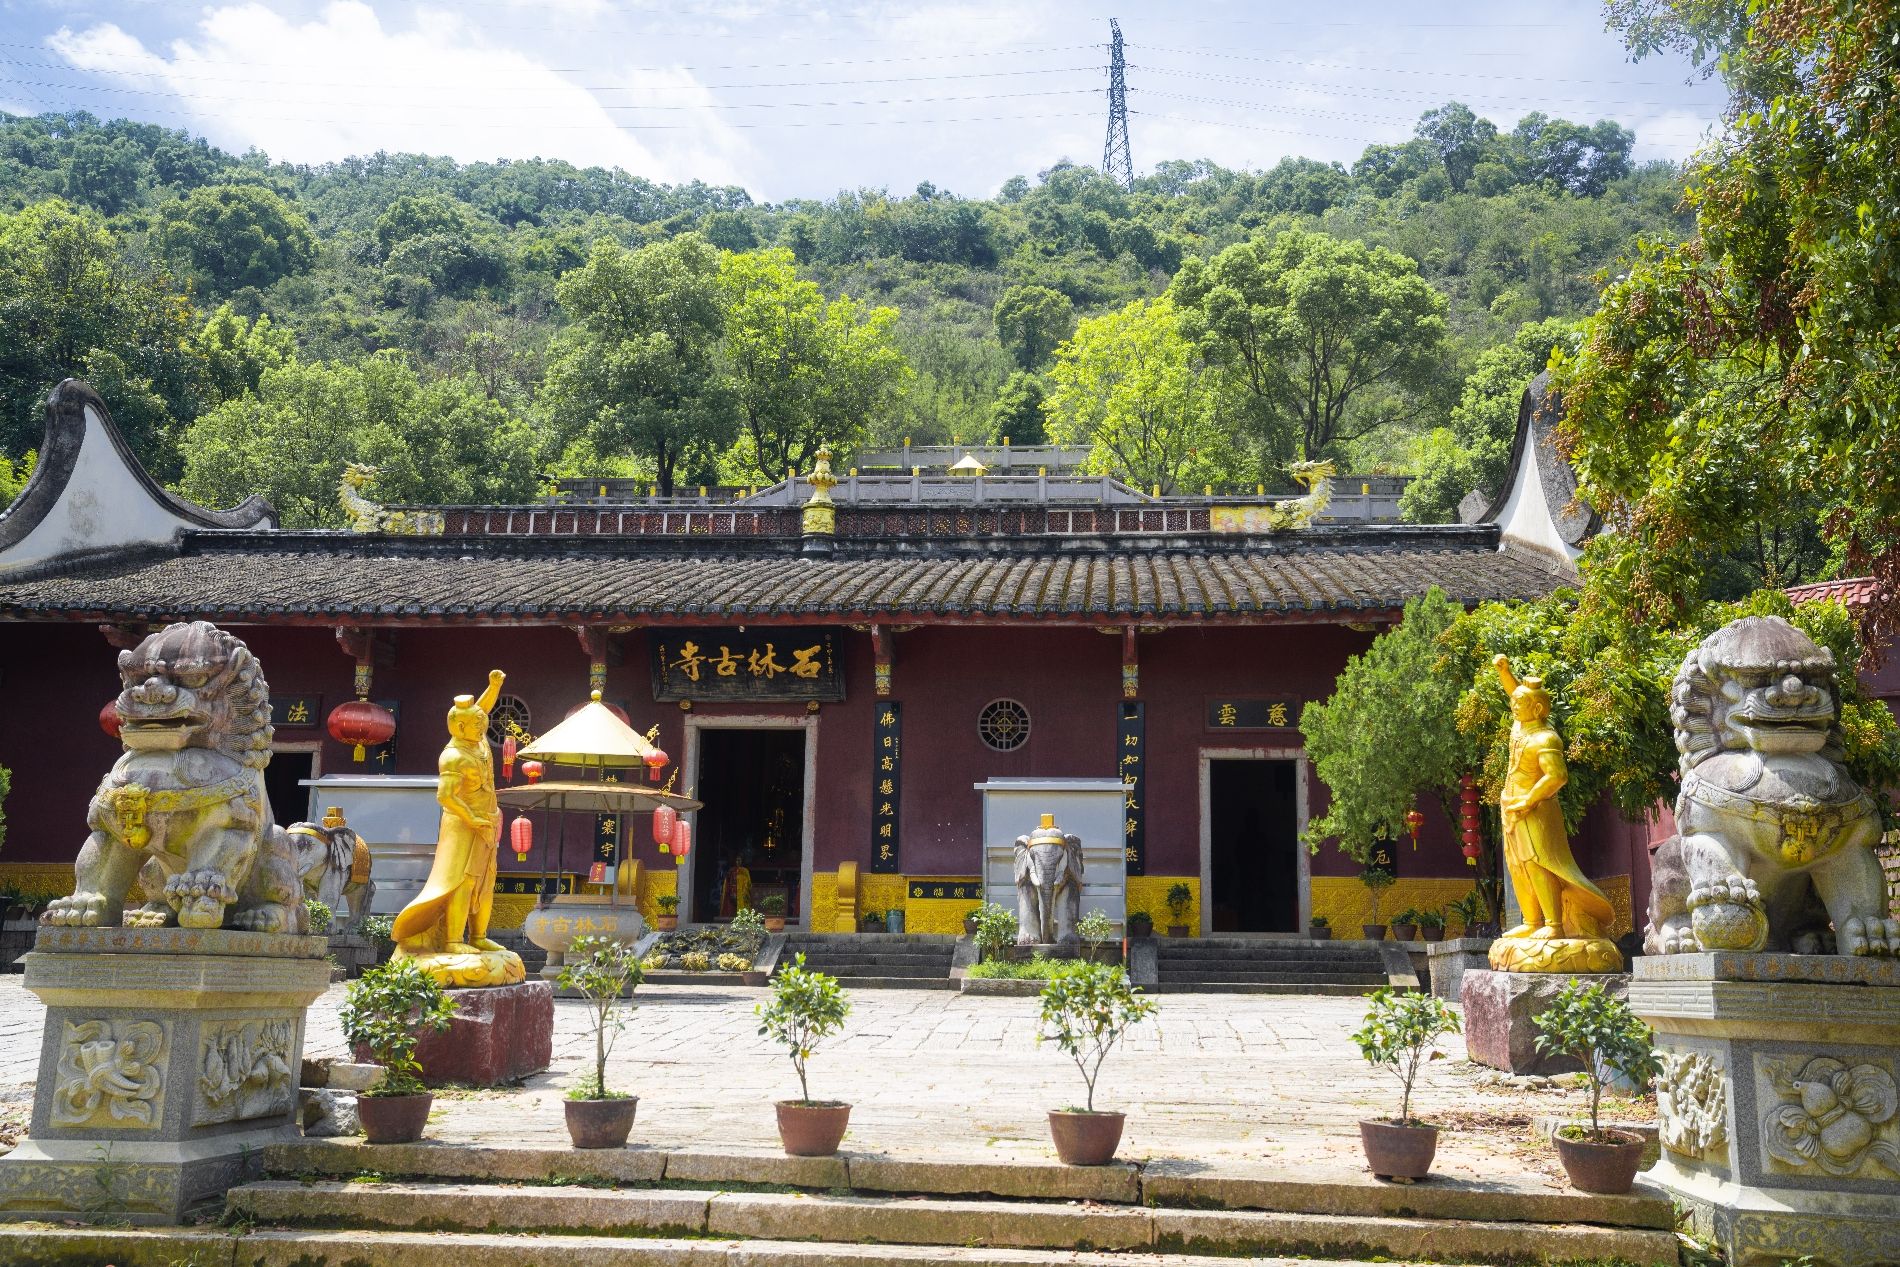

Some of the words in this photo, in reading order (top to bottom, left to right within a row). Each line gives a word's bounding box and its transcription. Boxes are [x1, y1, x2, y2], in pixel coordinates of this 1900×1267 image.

[669, 641, 822, 682] 石林古寺
[1218, 702, 1289, 727] 慈雲
[880, 712, 896, 860] 佛日高懸光明界
